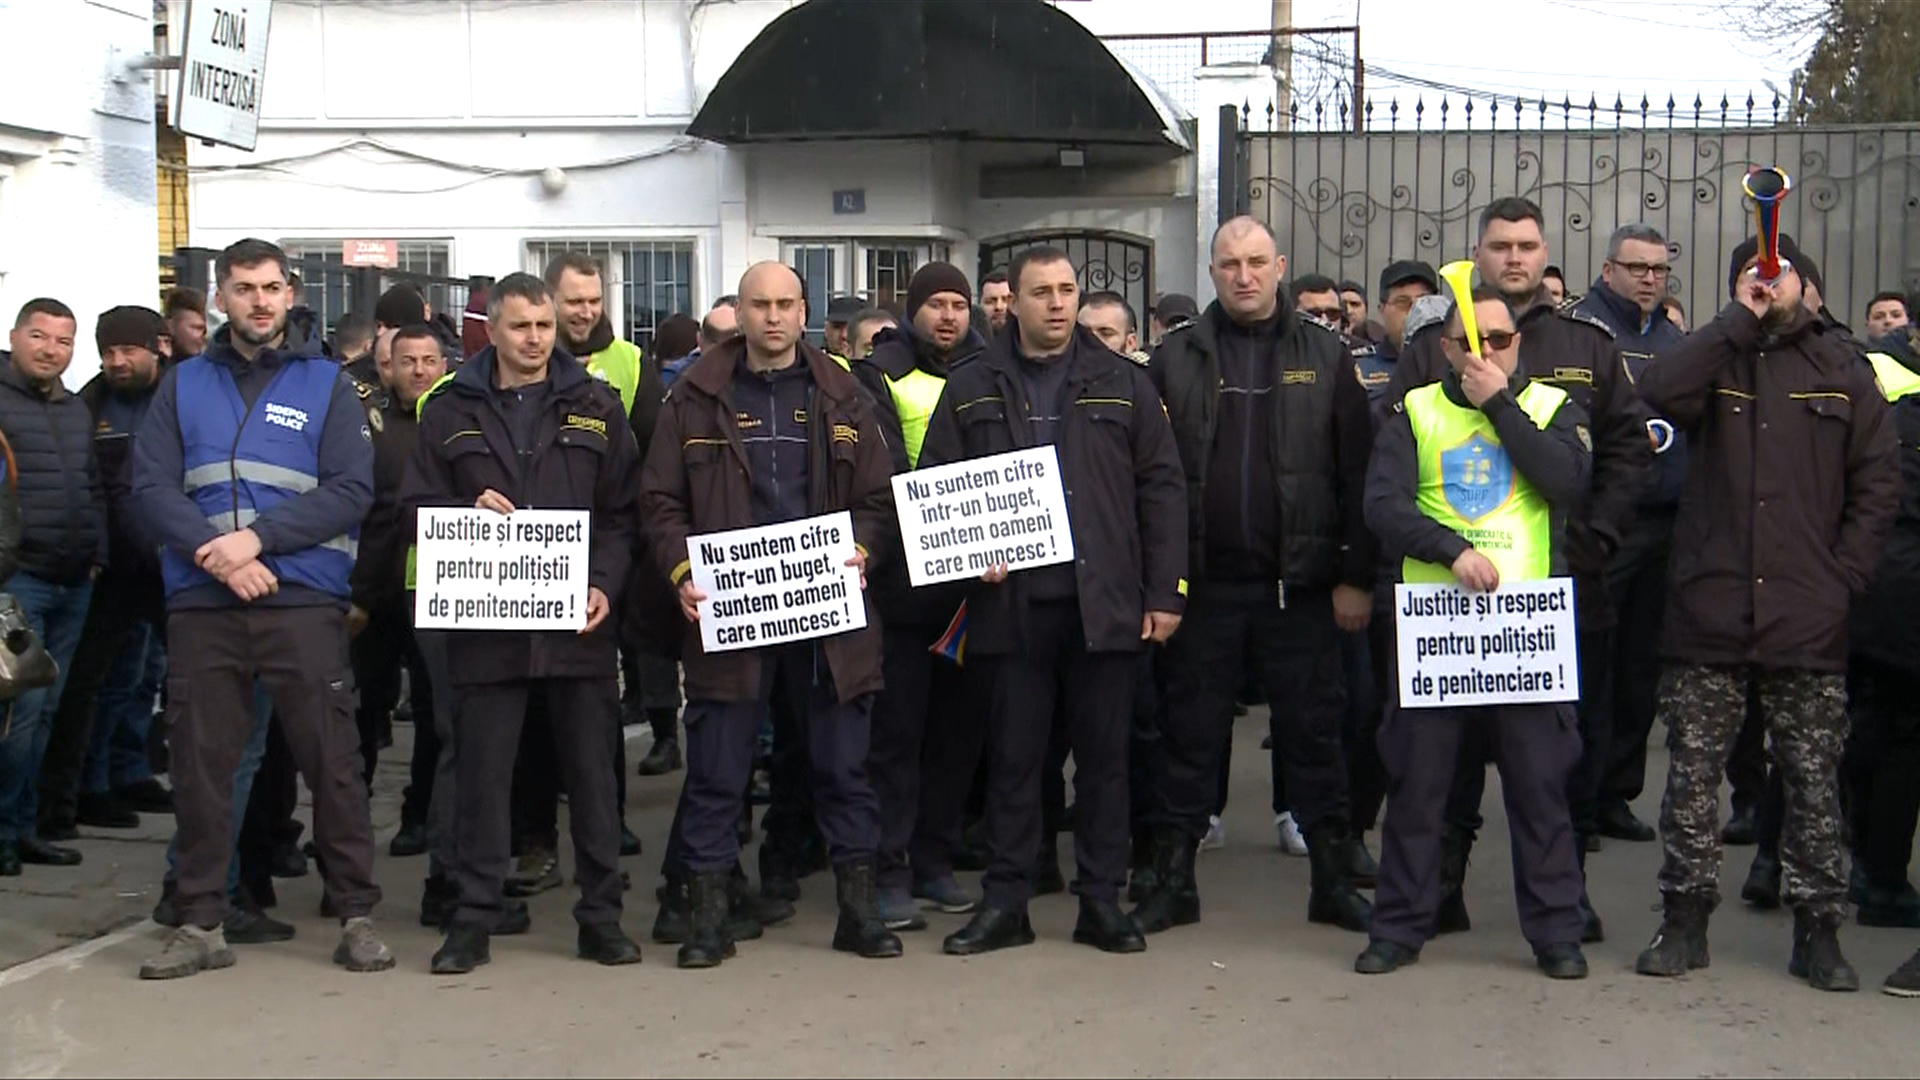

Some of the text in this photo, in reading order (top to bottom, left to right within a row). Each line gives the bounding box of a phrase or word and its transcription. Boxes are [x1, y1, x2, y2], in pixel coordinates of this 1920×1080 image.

[211, 7, 247, 52] ZONĂ
[190, 60, 257, 114] INTERZISĂ
[265, 403, 309, 423] SIDEPOL
[266, 413, 304, 431] POLICE
[906, 459, 1044, 501] Nu suntem cifre
[919, 486, 1041, 524] într-un buget,
[425, 515, 582, 549] Justiție și respect
[700, 525, 840, 565] Nu suntem cifre
[920, 508, 1053, 551] suntem oameni
[436, 555, 569, 587] pentru polițiștii
[713, 553, 836, 591] într-un buget,
[924, 535, 1057, 577] care muncesc !
[428, 592, 574, 624] de penitenciare !
[712, 575, 846, 618] suntem oameni
[1403, 586, 1566, 622] Justiție și respect
[716, 602, 850, 644] care muncesc !
[1417, 624, 1555, 663] pentru polițiștii
[1412, 663, 1564, 701] de penitenciare !
